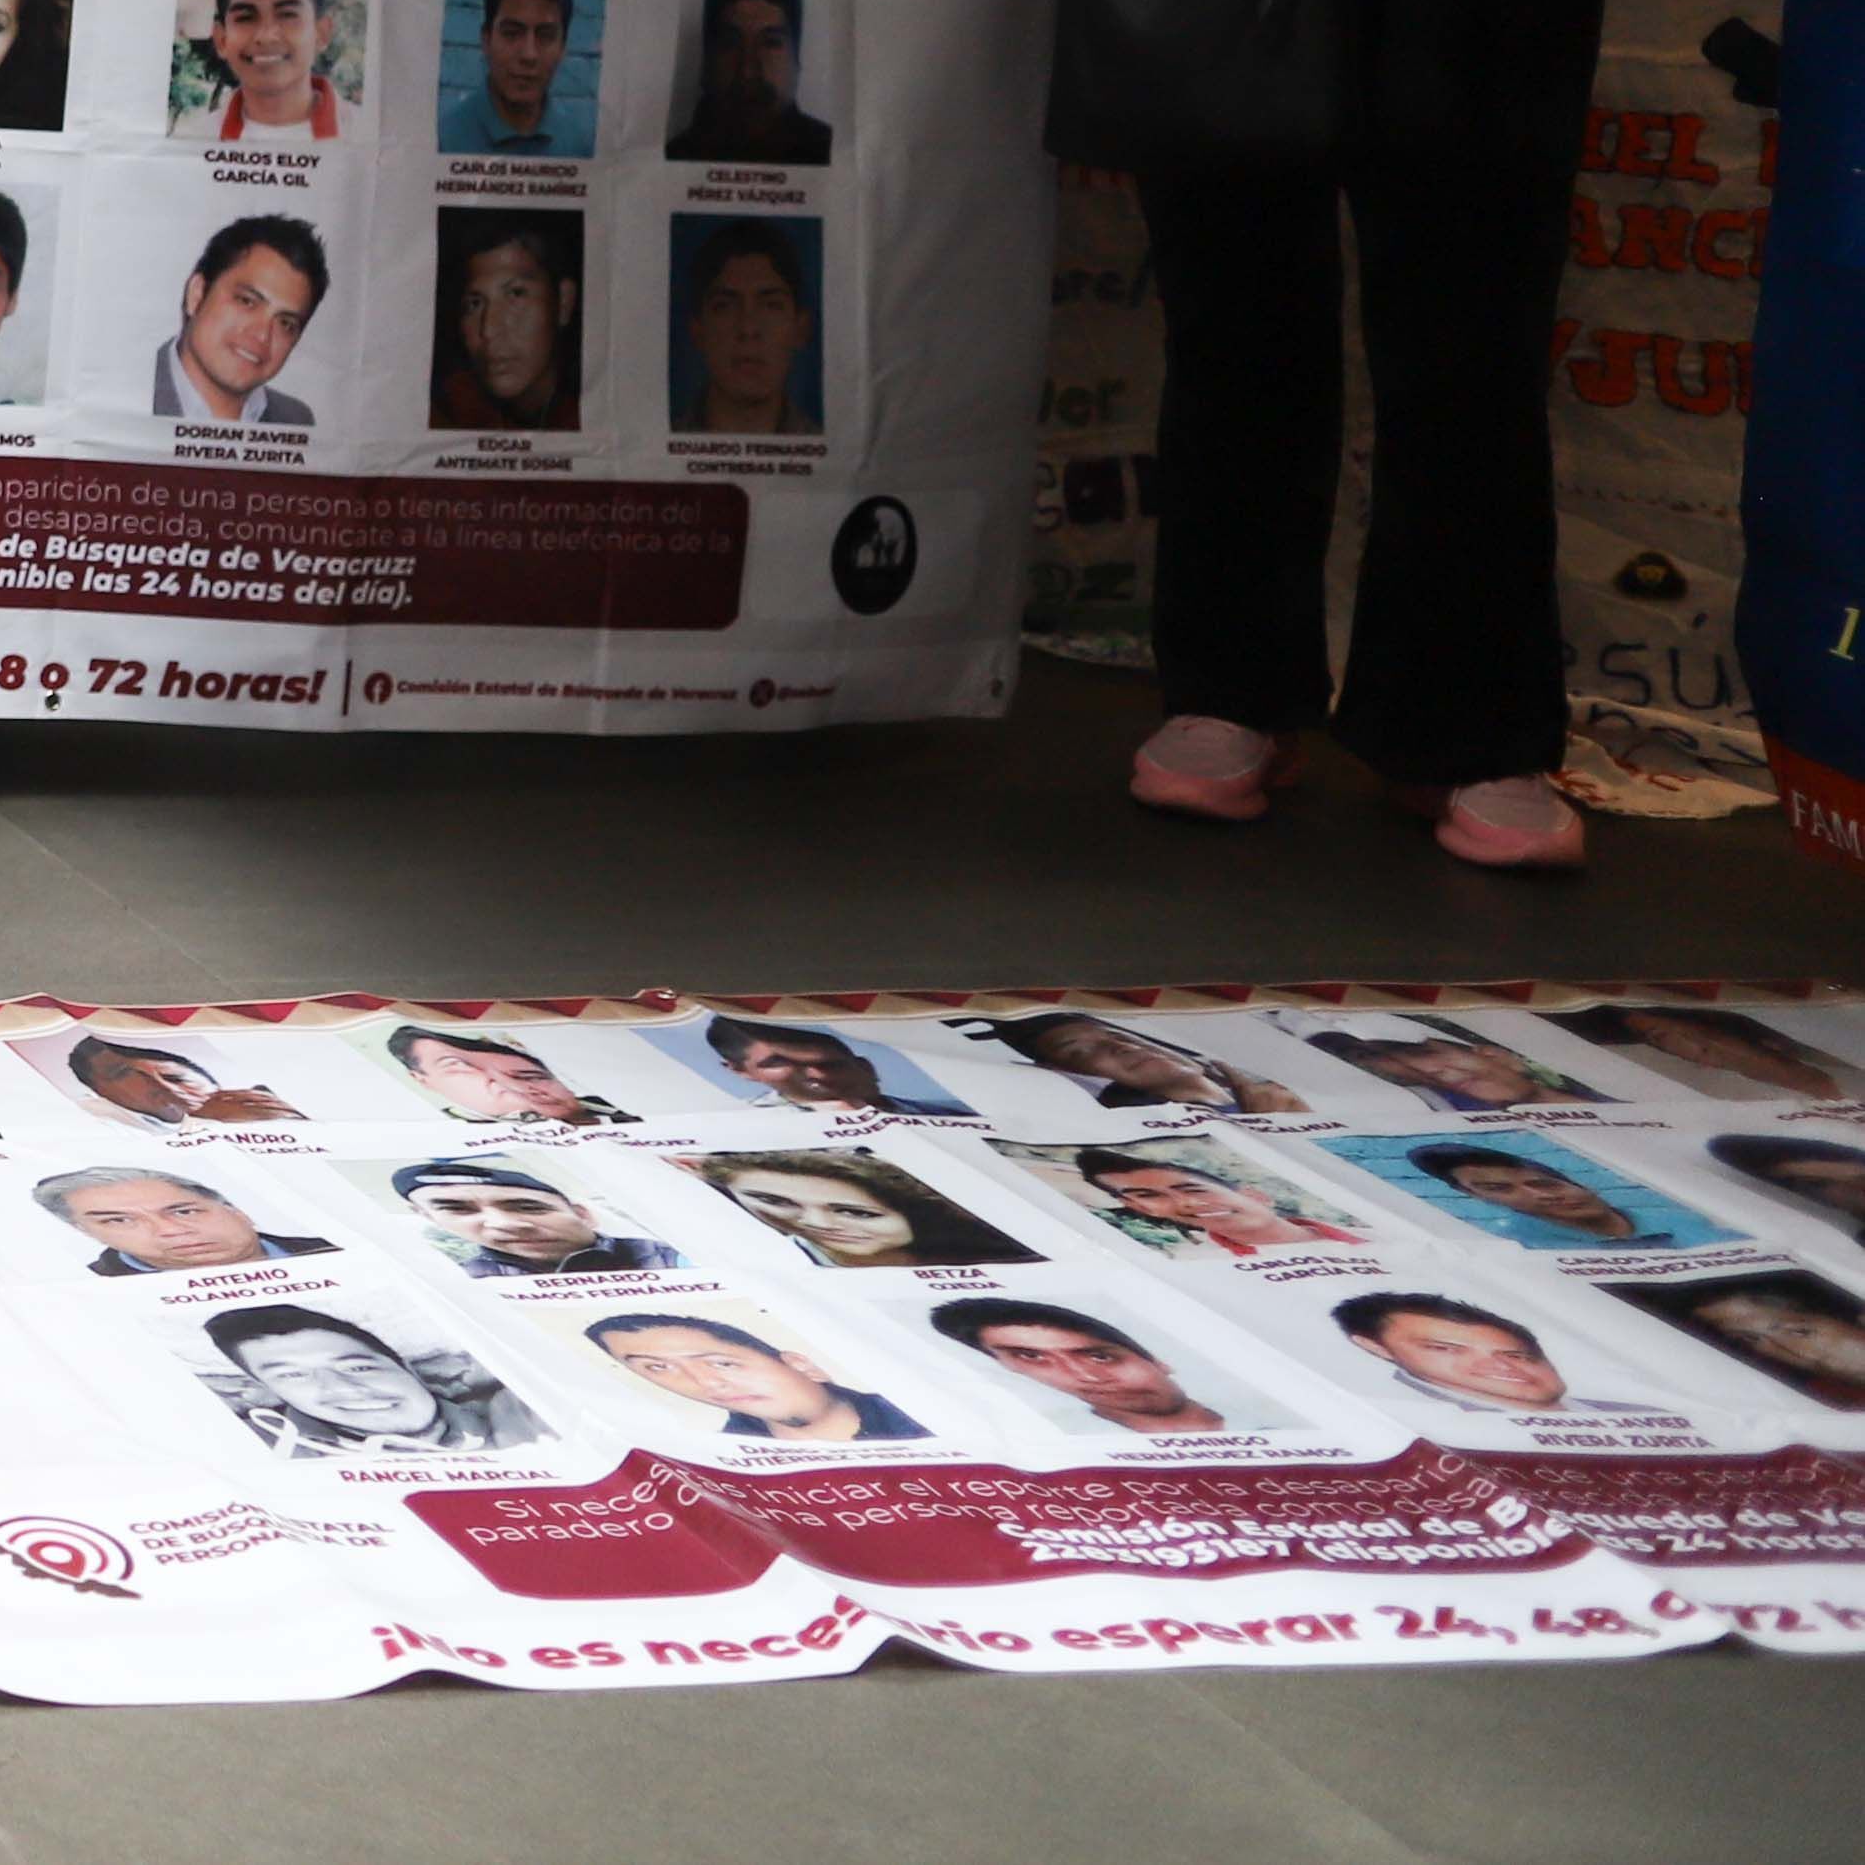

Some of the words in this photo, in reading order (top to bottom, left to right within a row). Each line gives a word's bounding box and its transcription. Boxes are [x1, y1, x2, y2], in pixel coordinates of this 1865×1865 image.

[44, 533, 214, 573] Búsqueda
[220, 544, 264, 571] de
[38, 661, 69, 692] o
[86, 658, 149, 695] 72
[156, 660, 329, 706] horas!
[185, 1268, 290, 1290] ARTEMIO
[261, 1275, 341, 1298] OJEDA
[912, 1266, 989, 1282] BETZA
[465, 1508, 676, 1548] paradero
